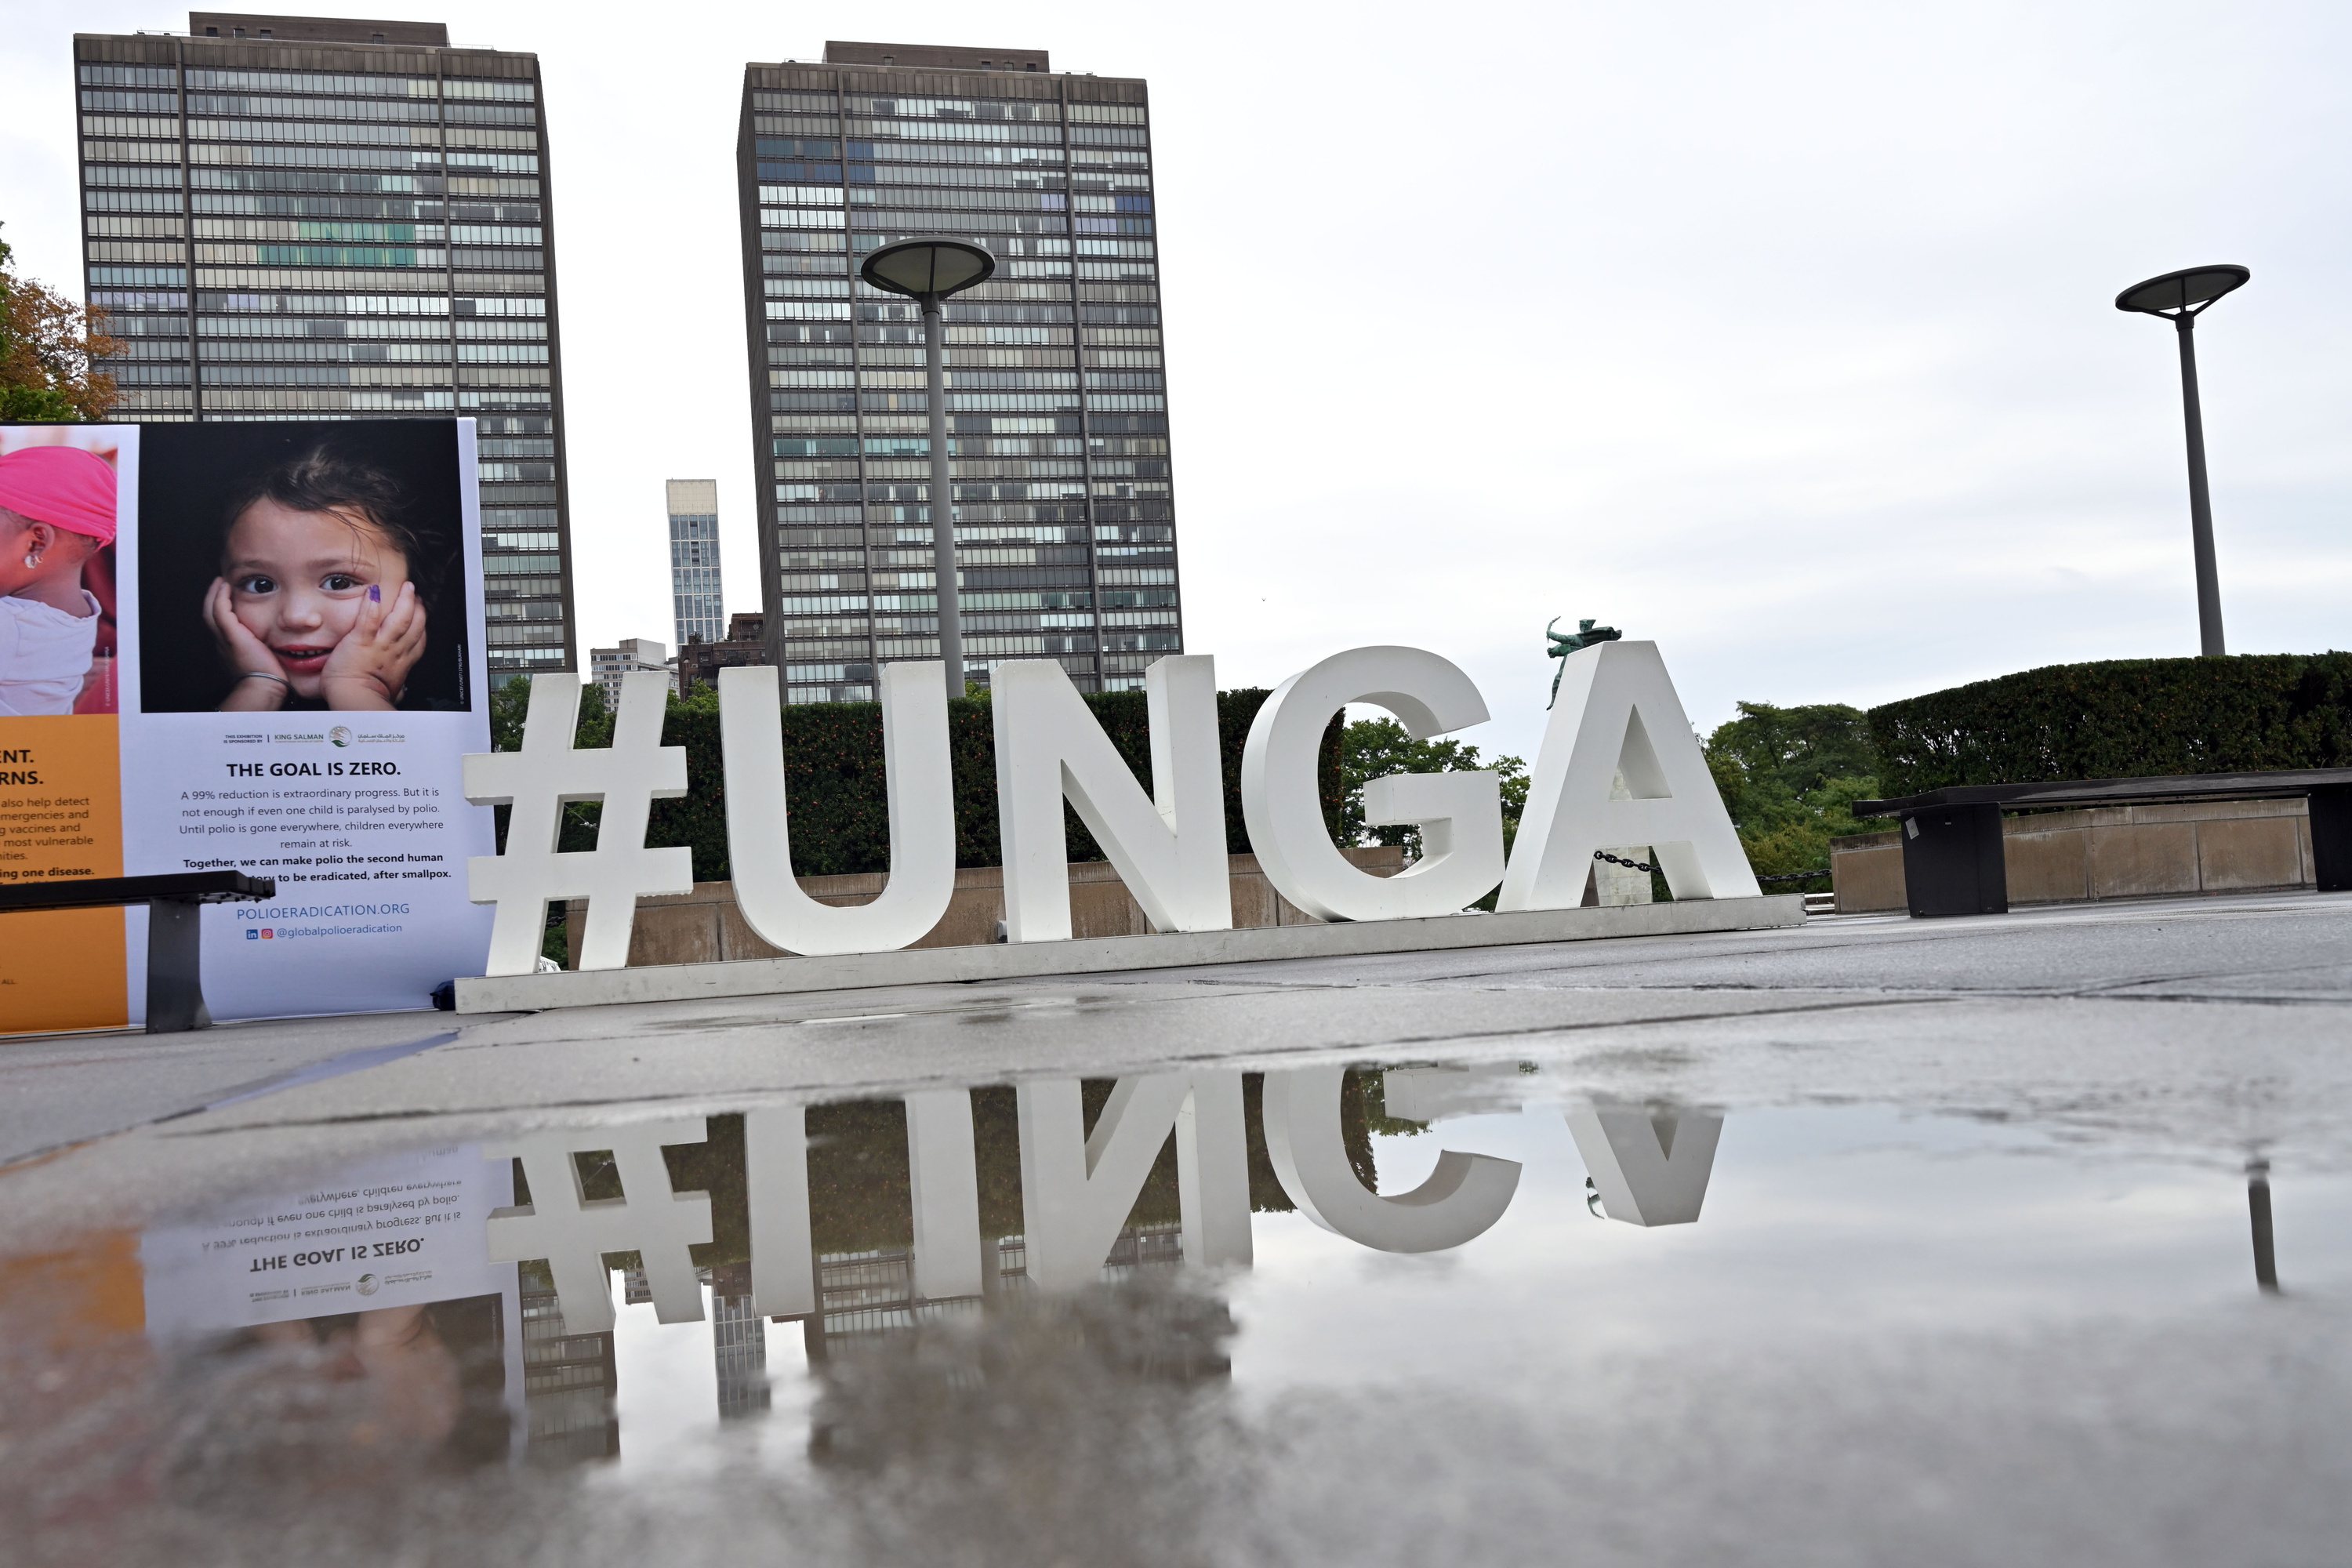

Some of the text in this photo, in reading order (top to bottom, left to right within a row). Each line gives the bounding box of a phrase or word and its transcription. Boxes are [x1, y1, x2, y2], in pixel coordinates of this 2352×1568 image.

[0, 750, 34, 764] NT.
[226, 762, 401, 777] THE GOAL IS ZERO.
[181, 787, 439, 800] A 99% reduction is extraordinary progress. But it is
[1, 797, 90, 808] also help detect
[462, 640, 1762, 977] #UNGA
[0, 810, 89, 822] mergencies and
[182, 808, 200, 817] not
[203, 808, 245, 818] enough
[248, 807, 255, 816] if
[309, 805, 333, 815] child
[336, 805, 344, 814] is
[347, 804, 395, 816] paralysed
[398, 804, 410, 815] by
[413, 804, 440, 815] polio.
[9, 823, 56, 833] vaccines
[60, 823, 81, 833] and
[180, 820, 444, 836] Until polio is gone everywhere, children everywhere
[4, 836, 93, 848] most vulnerable
[280, 838, 353, 849] remain at risk.
[183, 858, 237, 870] Together,
[282, 856, 312, 865] make
[315, 855, 343, 866] polio
[347, 855, 365, 863] the
[367, 854, 405, 863] second
[408, 853, 444, 862] human
[48, 867, 95, 877] disease.
[293, 873, 307, 882] be
[310, 871, 370, 881] eradicated,
[373, 870, 399, 880] after
[402, 869, 452, 880] smallpox.
[237, 903, 410, 920] POLIOERADICATION.ORG
[277, 924, 402, 938] @globalpolioeradication
